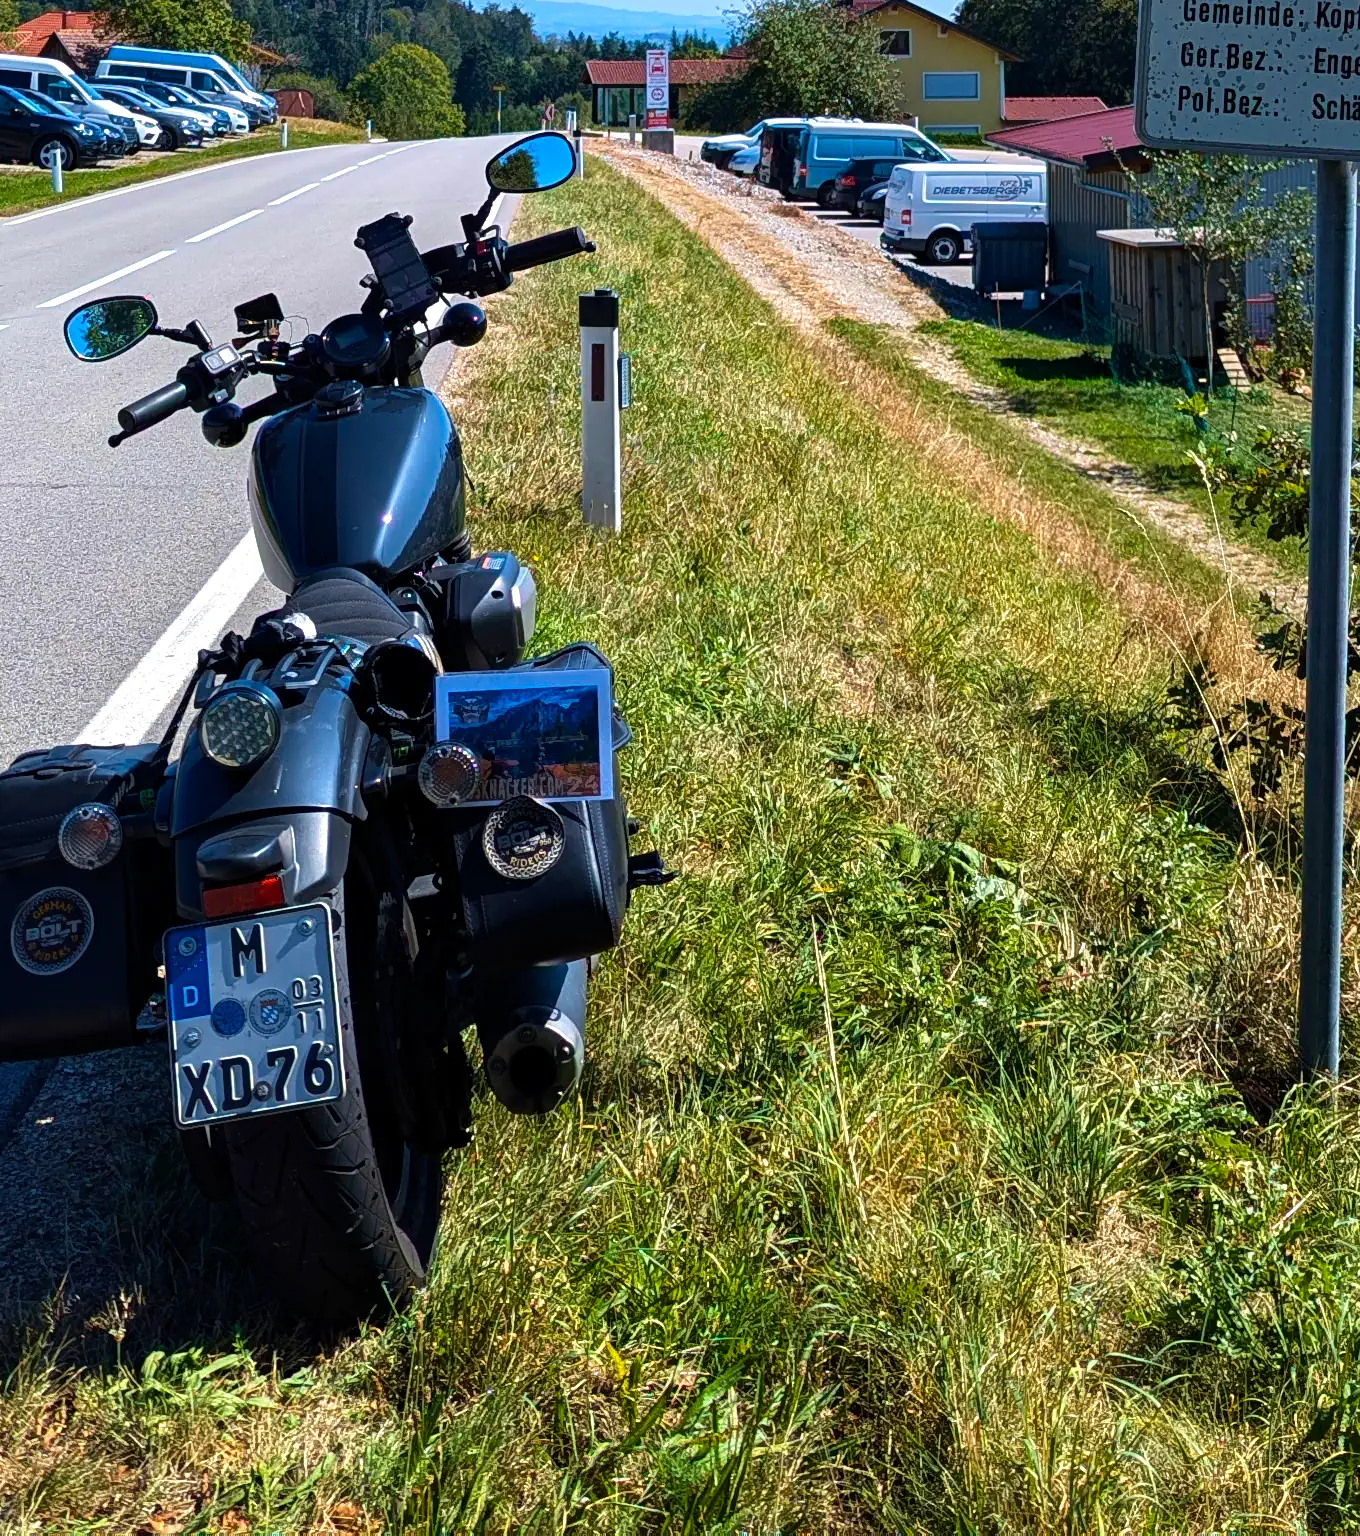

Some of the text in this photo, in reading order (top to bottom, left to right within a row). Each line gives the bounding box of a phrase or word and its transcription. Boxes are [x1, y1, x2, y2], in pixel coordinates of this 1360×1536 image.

[932, 186, 1029, 195] DIEBETSBERGER
[1000, 179, 1019, 187] KFZ
[566, 774, 600, 796] 24
[508, 848, 548, 868] RIDERS
[31, 899, 74, 921] GERMAN
[25, 919, 83, 942] BOLT
[231, 923, 267, 978] M
[183, 986, 199, 1008] D
[291, 974, 324, 1001] 03
[296, 1007, 325, 1034] 11
[266, 1040, 335, 1102] 76
